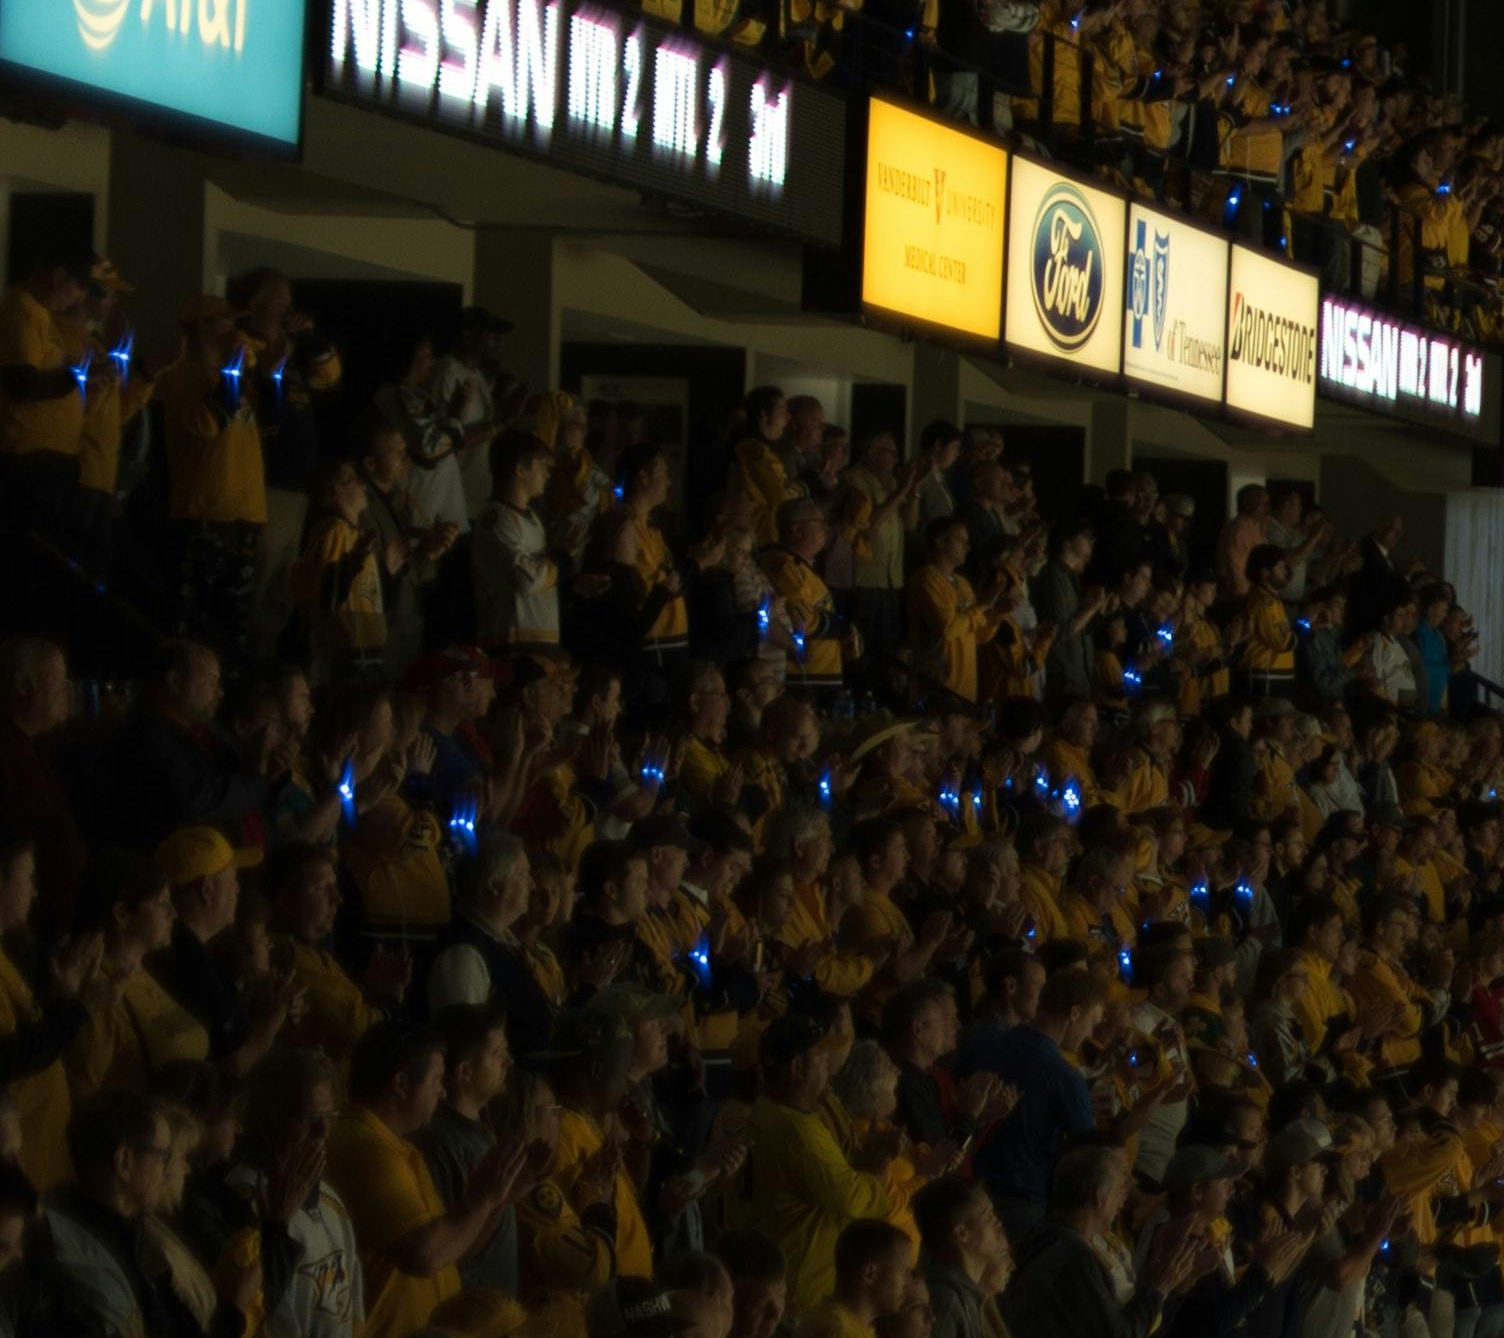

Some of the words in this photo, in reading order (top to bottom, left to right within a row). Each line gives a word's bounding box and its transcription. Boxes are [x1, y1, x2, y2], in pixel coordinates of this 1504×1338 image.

[877, 162, 931, 207] VANDERBILT
[947, 189, 995, 230] UNIVERSITY
[903, 243, 937, 277] MEDICAL
[938, 254, 968, 285] CENTER
[1043, 207, 1094, 323] Ford
[1178, 321, 1222, 376] Tennessee
[1230, 291, 1316, 386] BRIDGESTONE
[1321, 299, 1400, 402] NISSAN
